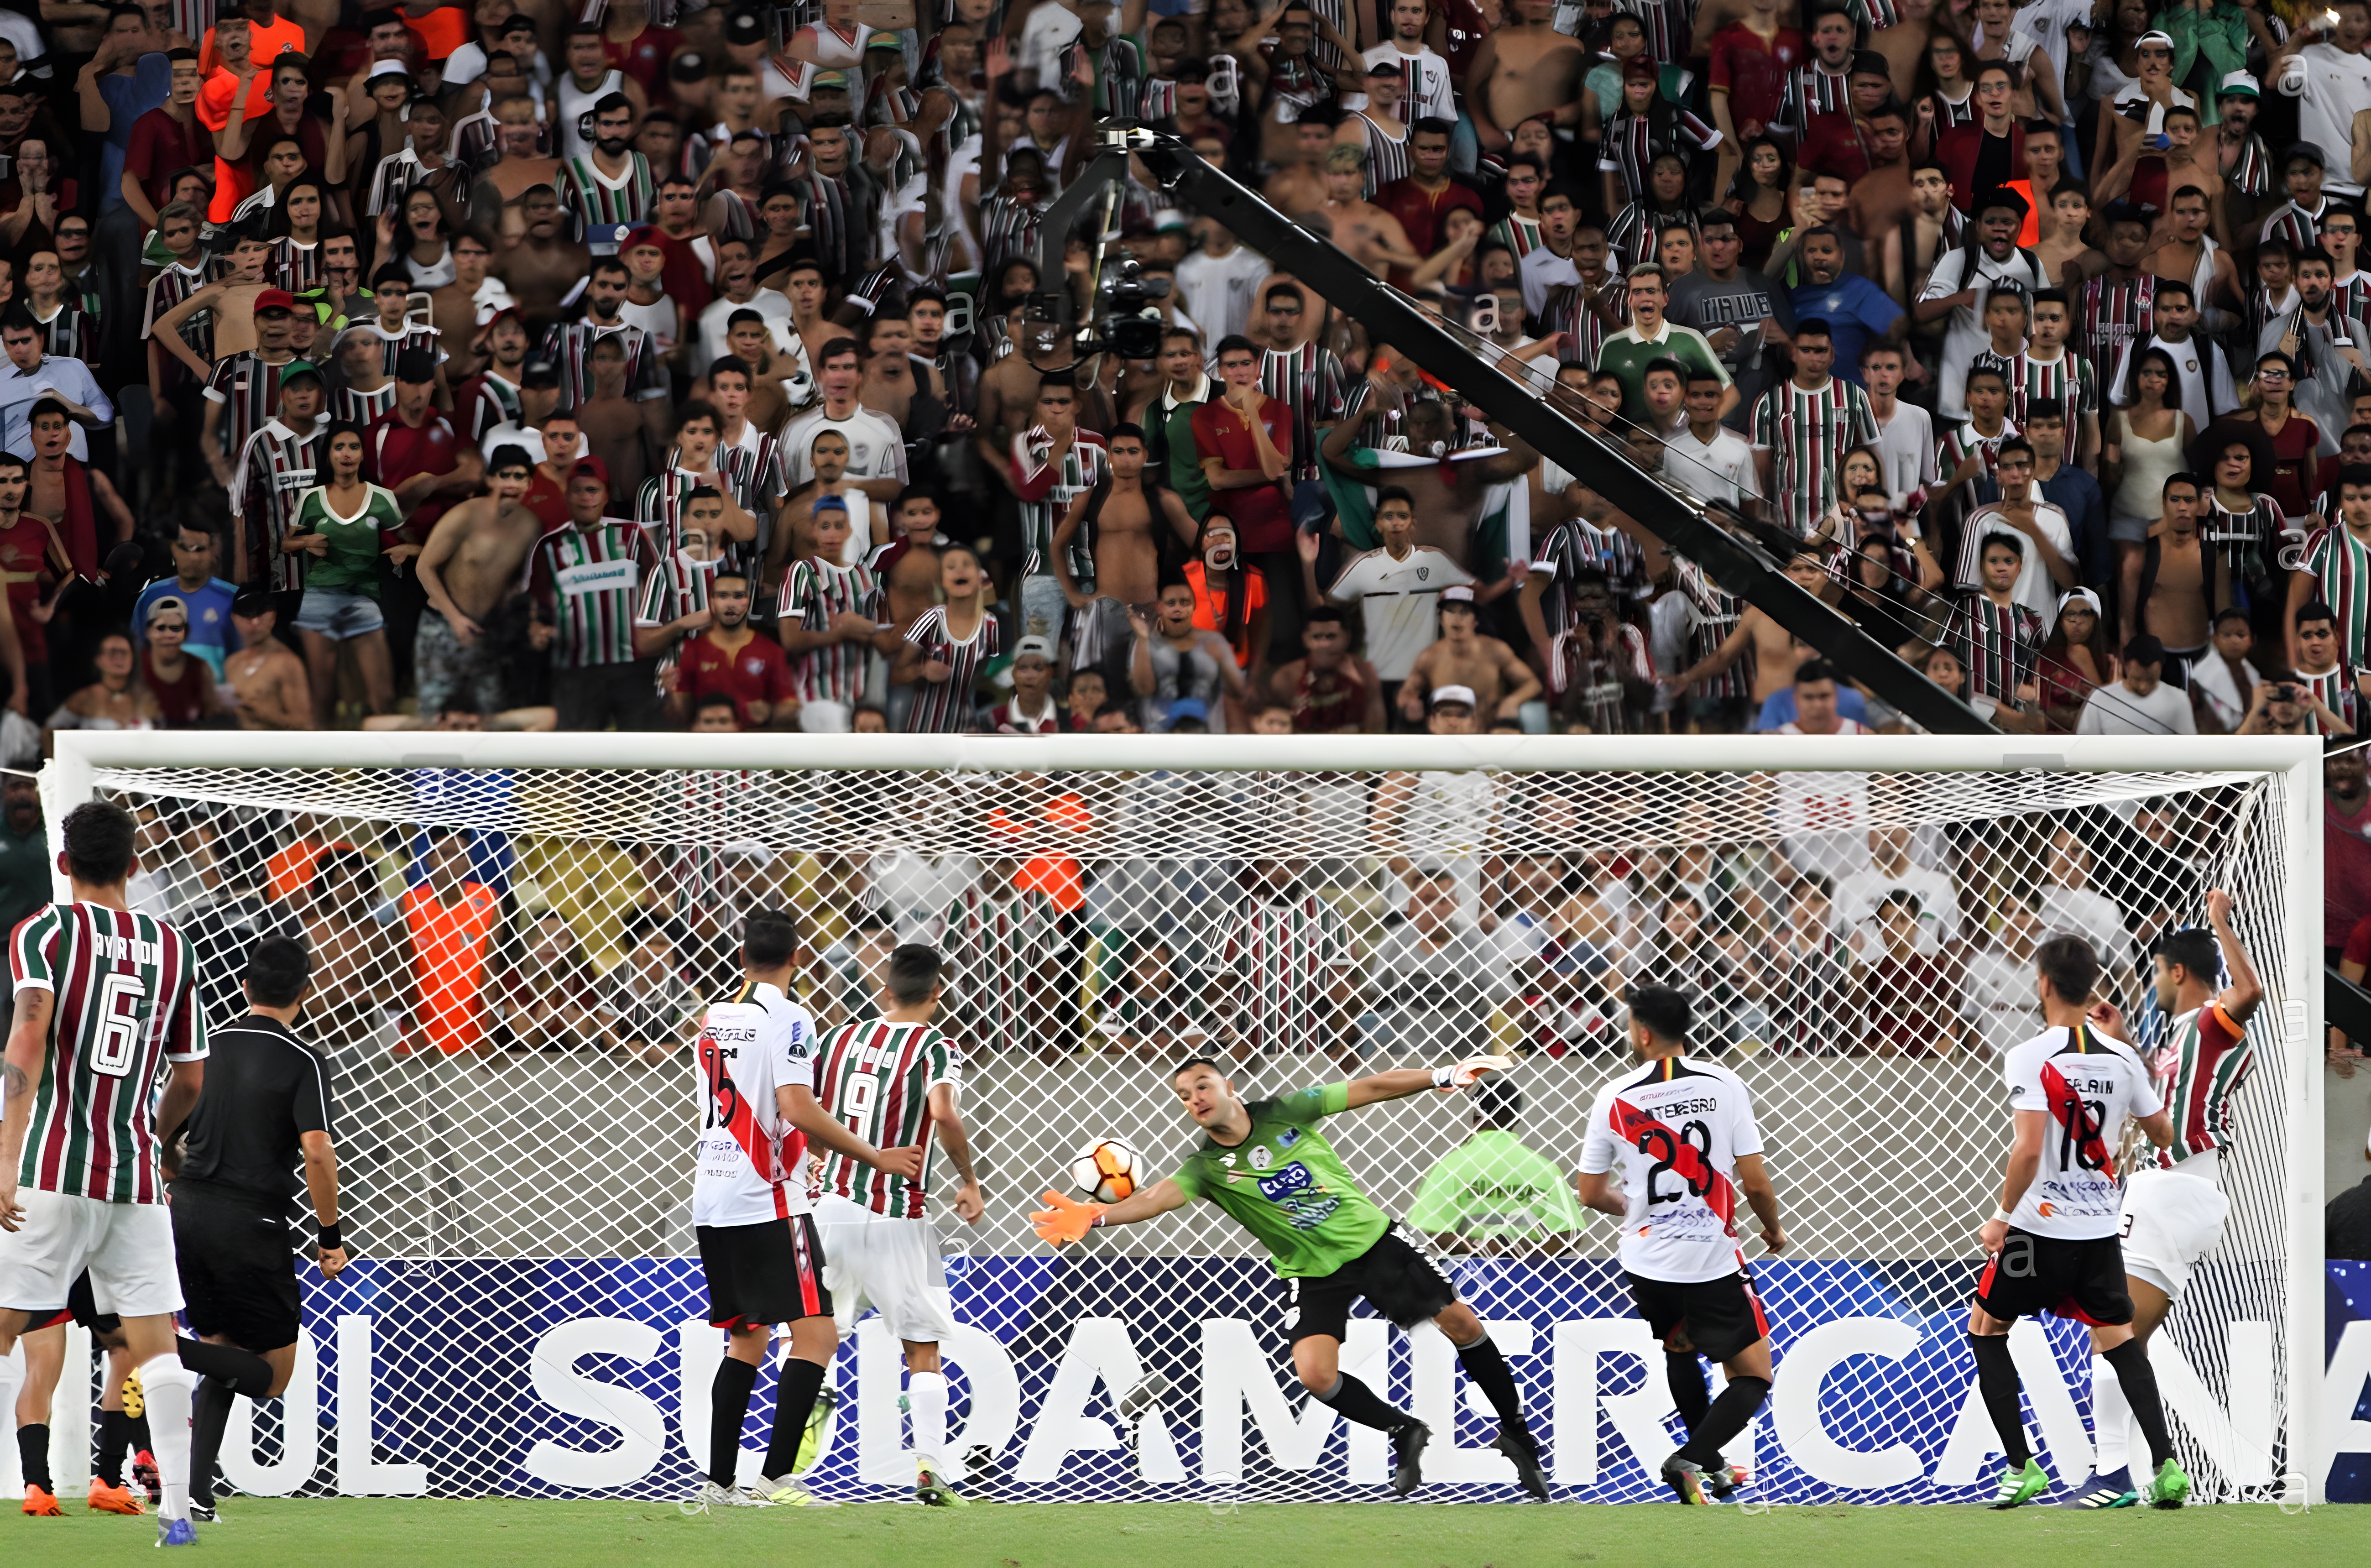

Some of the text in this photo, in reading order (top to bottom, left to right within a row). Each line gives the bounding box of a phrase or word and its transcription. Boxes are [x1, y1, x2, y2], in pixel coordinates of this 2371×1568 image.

[90, 973, 146, 1077] 6
[843, 1072, 879, 1142] 9
[526, 1316, 2371, 1489] SUDAMERCAN
